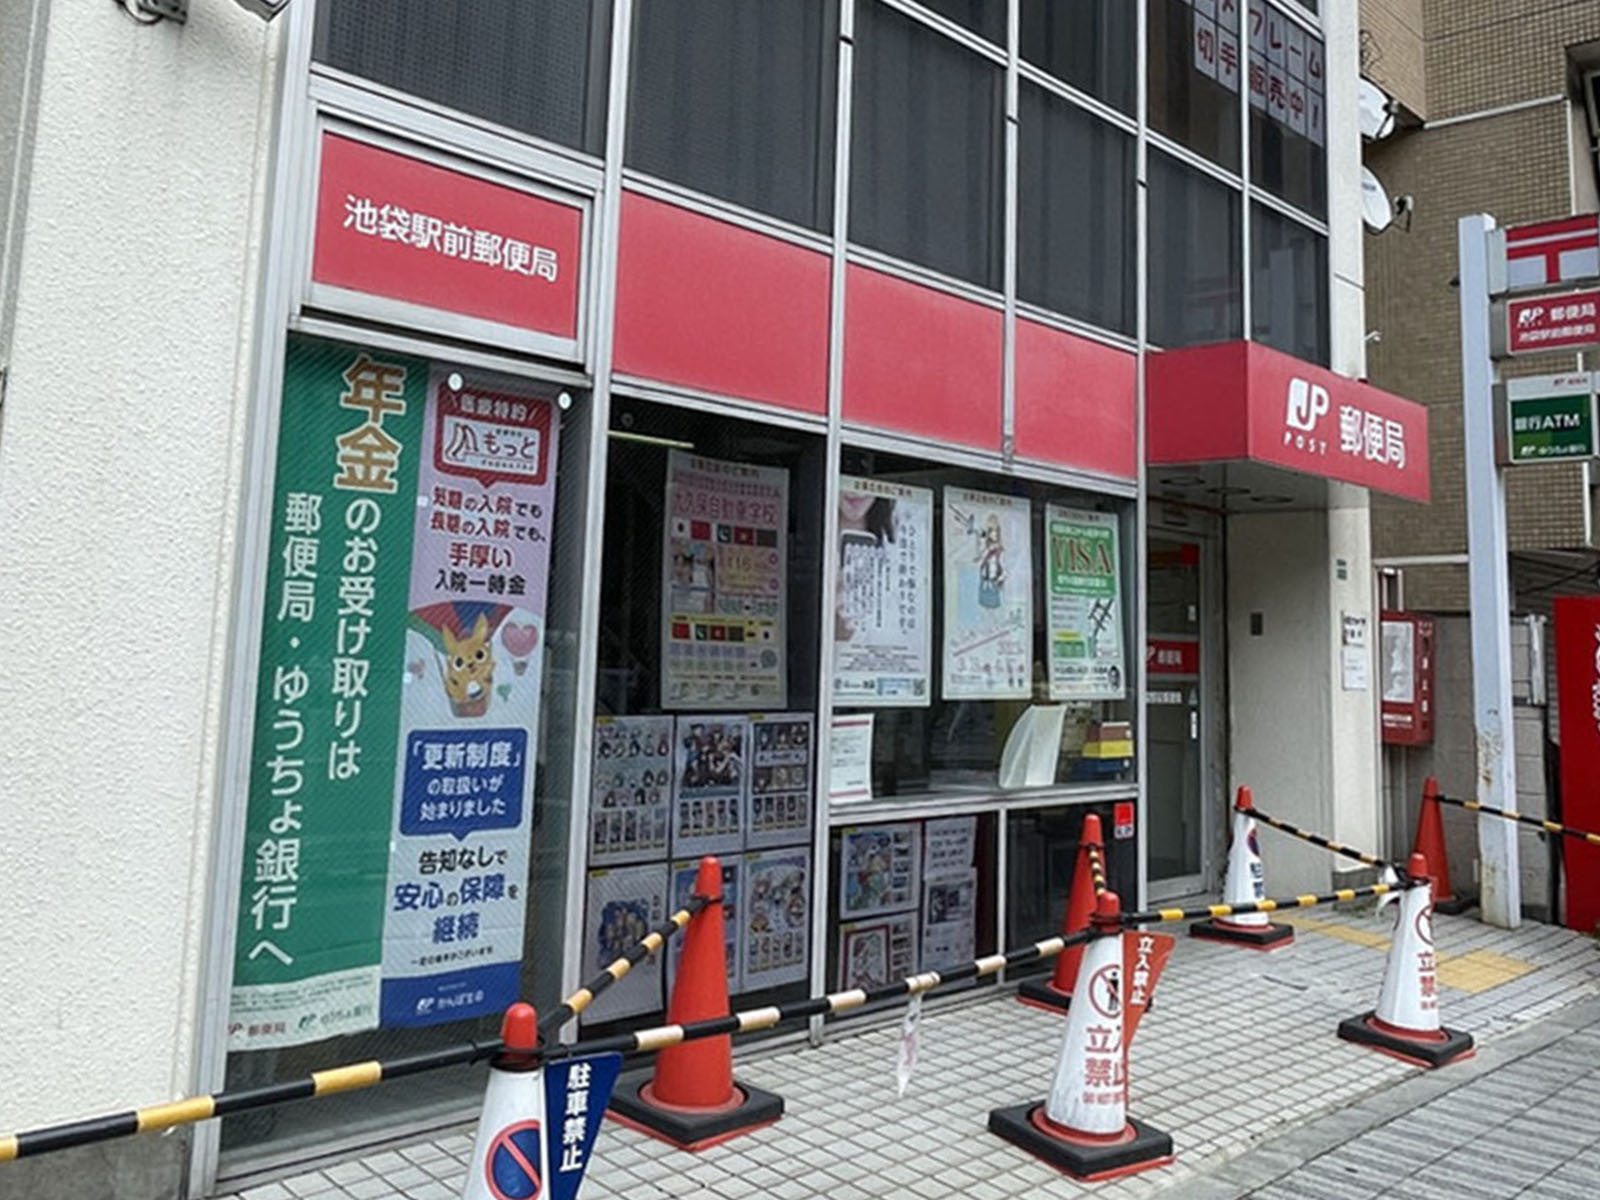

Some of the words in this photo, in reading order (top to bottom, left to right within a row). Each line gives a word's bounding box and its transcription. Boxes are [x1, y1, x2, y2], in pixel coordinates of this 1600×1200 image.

[343, 194, 558, 282] 池袋駅前郵便局
[484, 432, 537, 460] もっと
[1283, 431, 1327, 456] POST
[1339, 405, 1406, 470] 郵便局
[328, 352, 407, 781] 年金のお受け取りは
[449, 542, 511, 568] 手厚い
[1051, 536, 1112, 575] VISA
[435, 569, 526, 595] 入院一時金
[248, 492, 323, 966] 郵便局・ゆうちょ銀行へ
[427, 774, 504, 796] の取扱いが
[420, 798, 506, 821] 始まりました
[418, 846, 507, 875] 告知なしで
[394, 873, 518, 912] 安心の保障を
[433, 912, 480, 944] 継続
[1130, 936, 1155, 1006] 立入禁止
[559, 1062, 593, 1173] 駐車禁止
